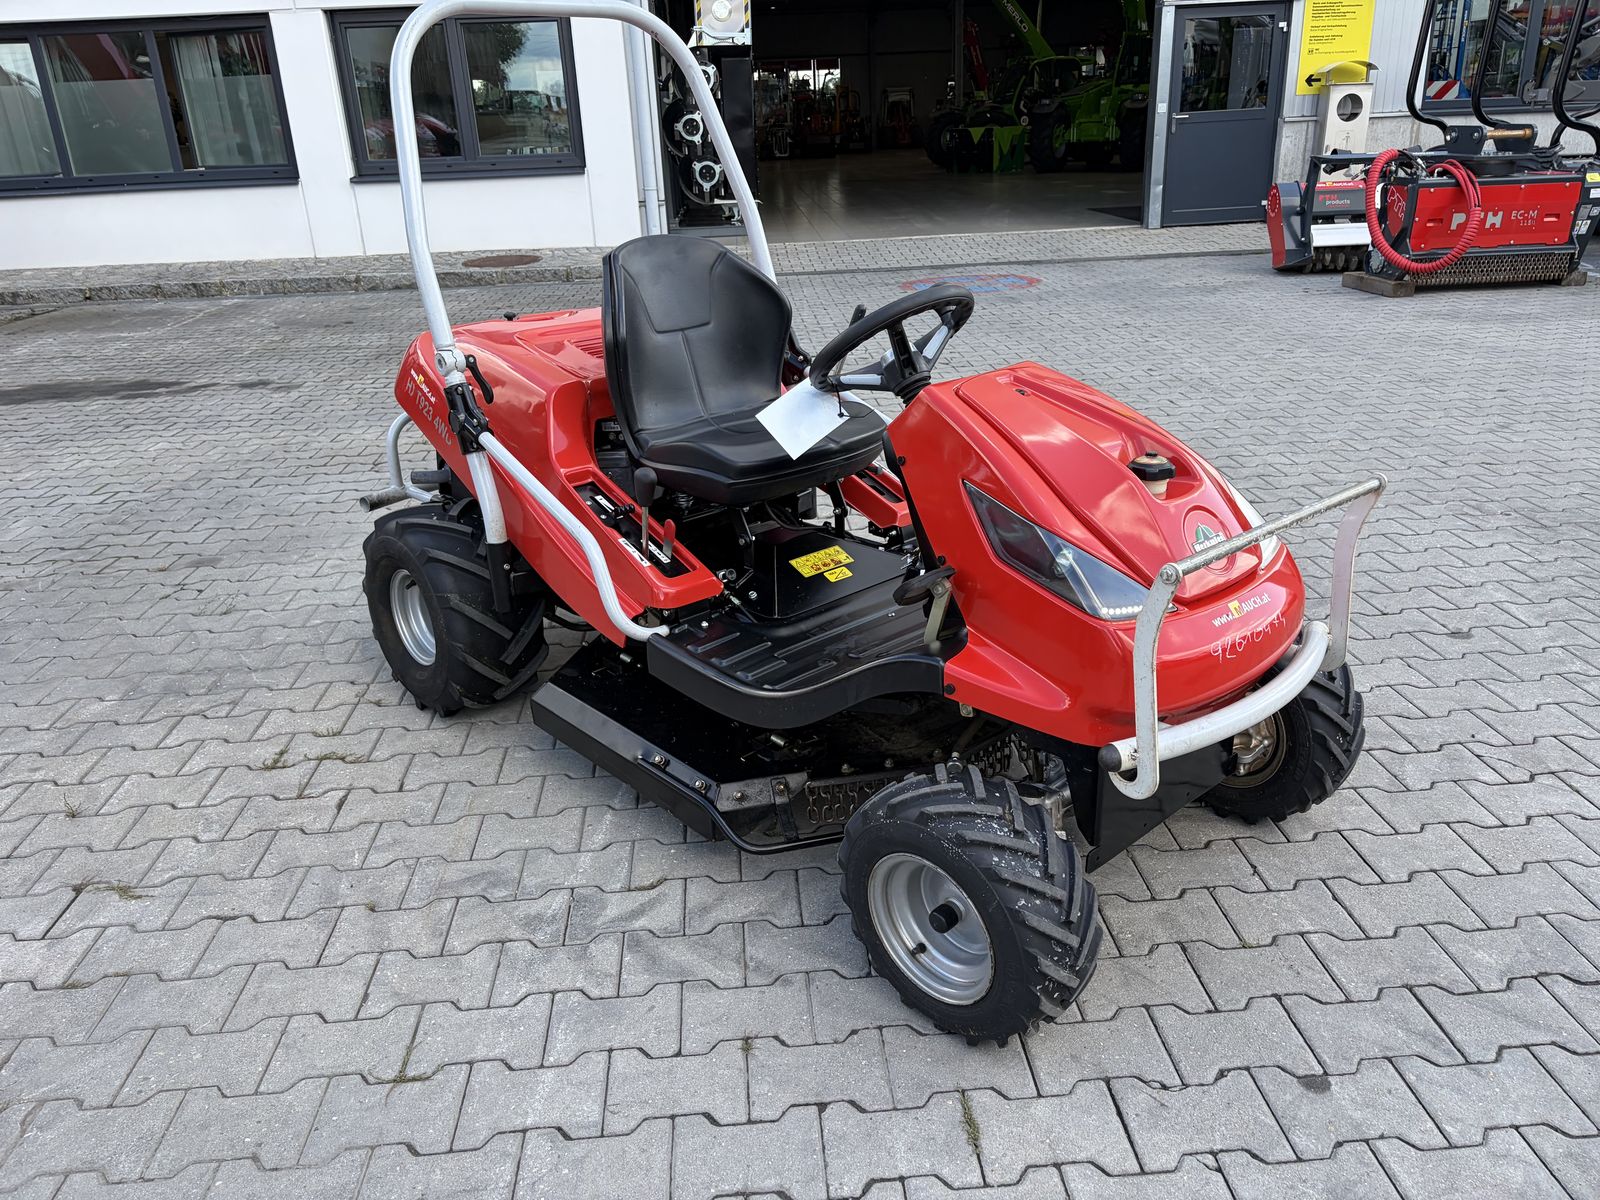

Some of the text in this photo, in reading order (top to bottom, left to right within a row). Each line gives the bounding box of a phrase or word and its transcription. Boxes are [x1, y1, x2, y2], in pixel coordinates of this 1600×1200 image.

[1002, 0, 1029, 32] MERLO
[1450, 210, 1538, 230] PH EC-M
[416, 391, 433, 421] T923
[1212, 592, 1271, 628] www.MAUCH.at
